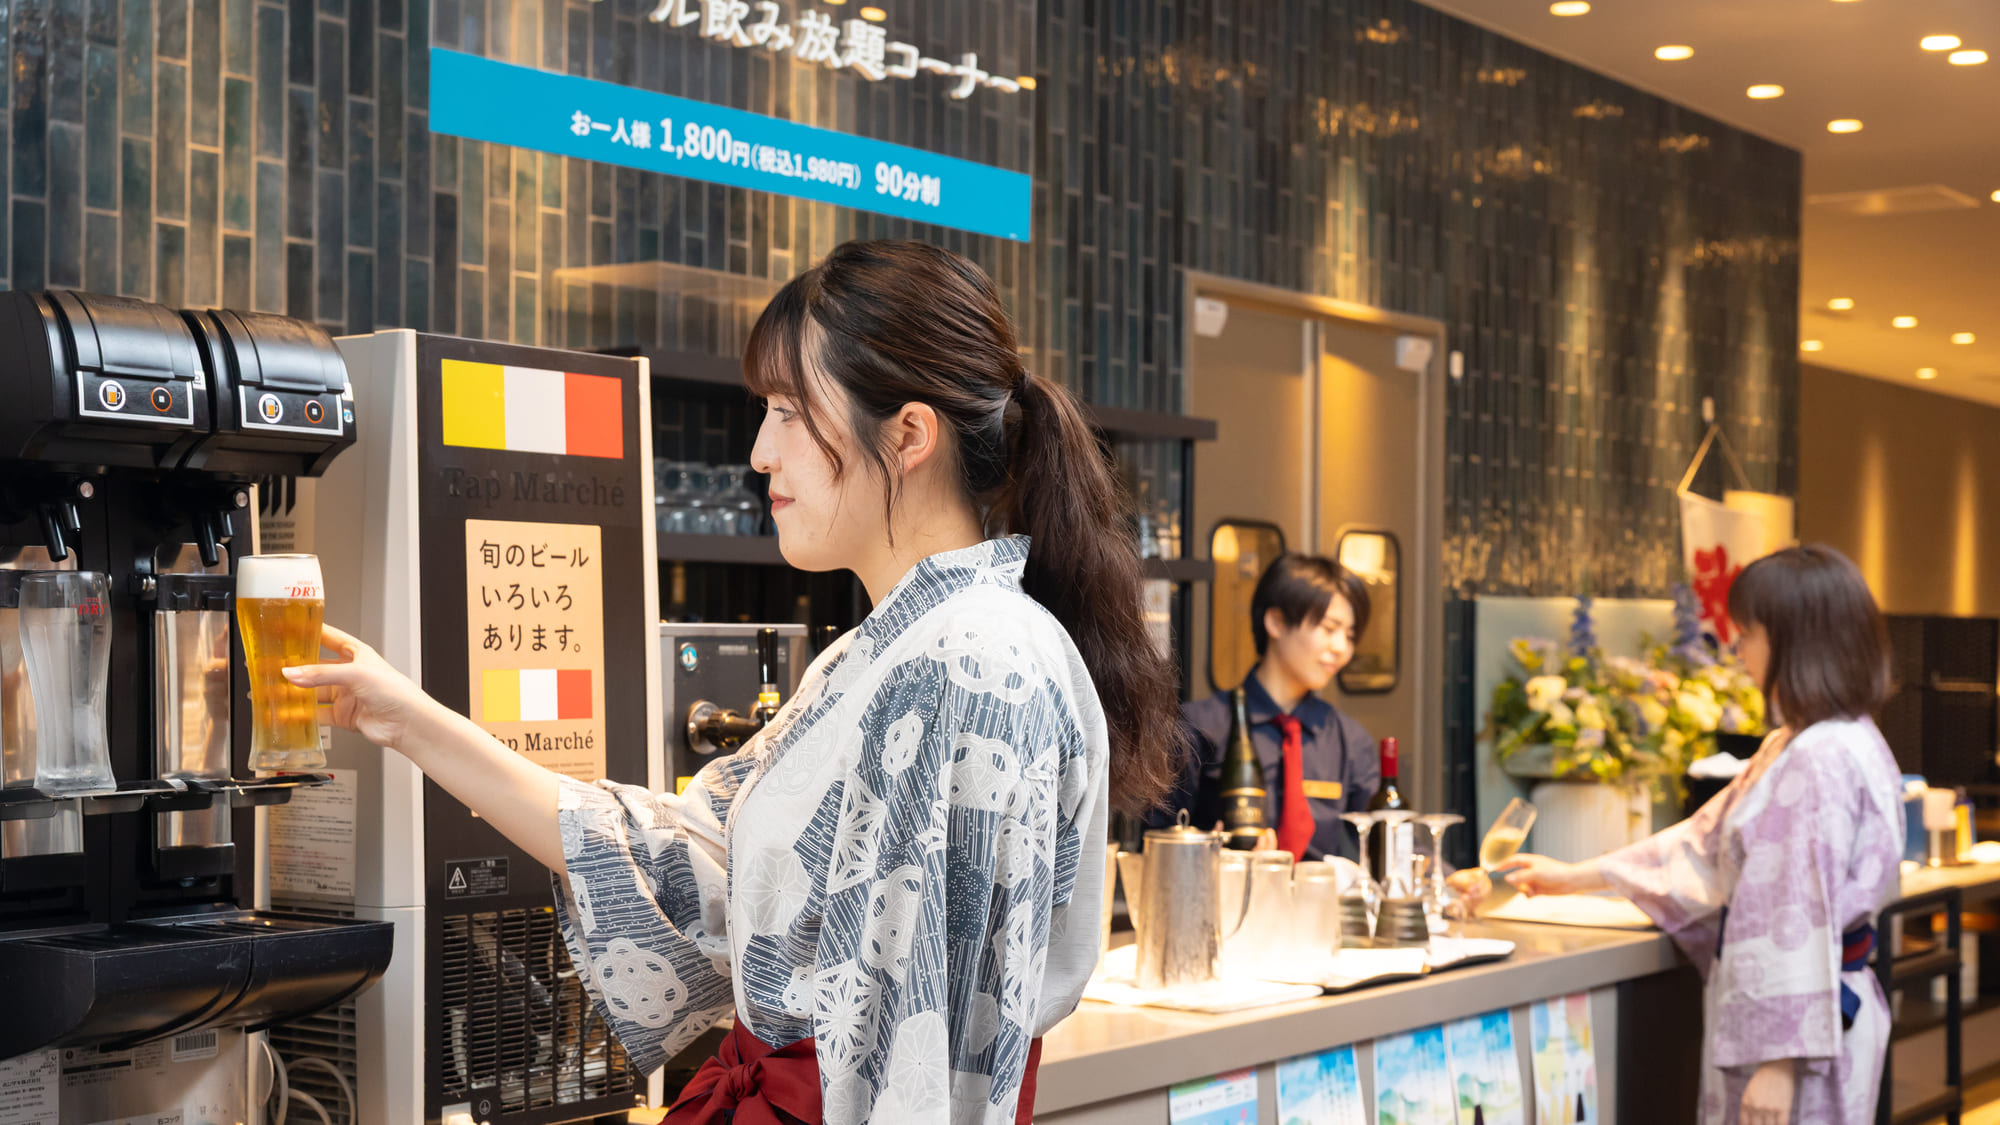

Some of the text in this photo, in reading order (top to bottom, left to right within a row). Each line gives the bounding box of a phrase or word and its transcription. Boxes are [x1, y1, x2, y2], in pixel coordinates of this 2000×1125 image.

[570, 110, 651, 149] お一人様
[875, 161, 941, 207] 90分制
[441, 467, 624, 509] Tap Marché
[480, 540, 589, 568] 旬のビール
[482, 584, 572, 611] いろいろ
[483, 624, 581, 652] あります。
[525, 730, 594, 751] Marché
